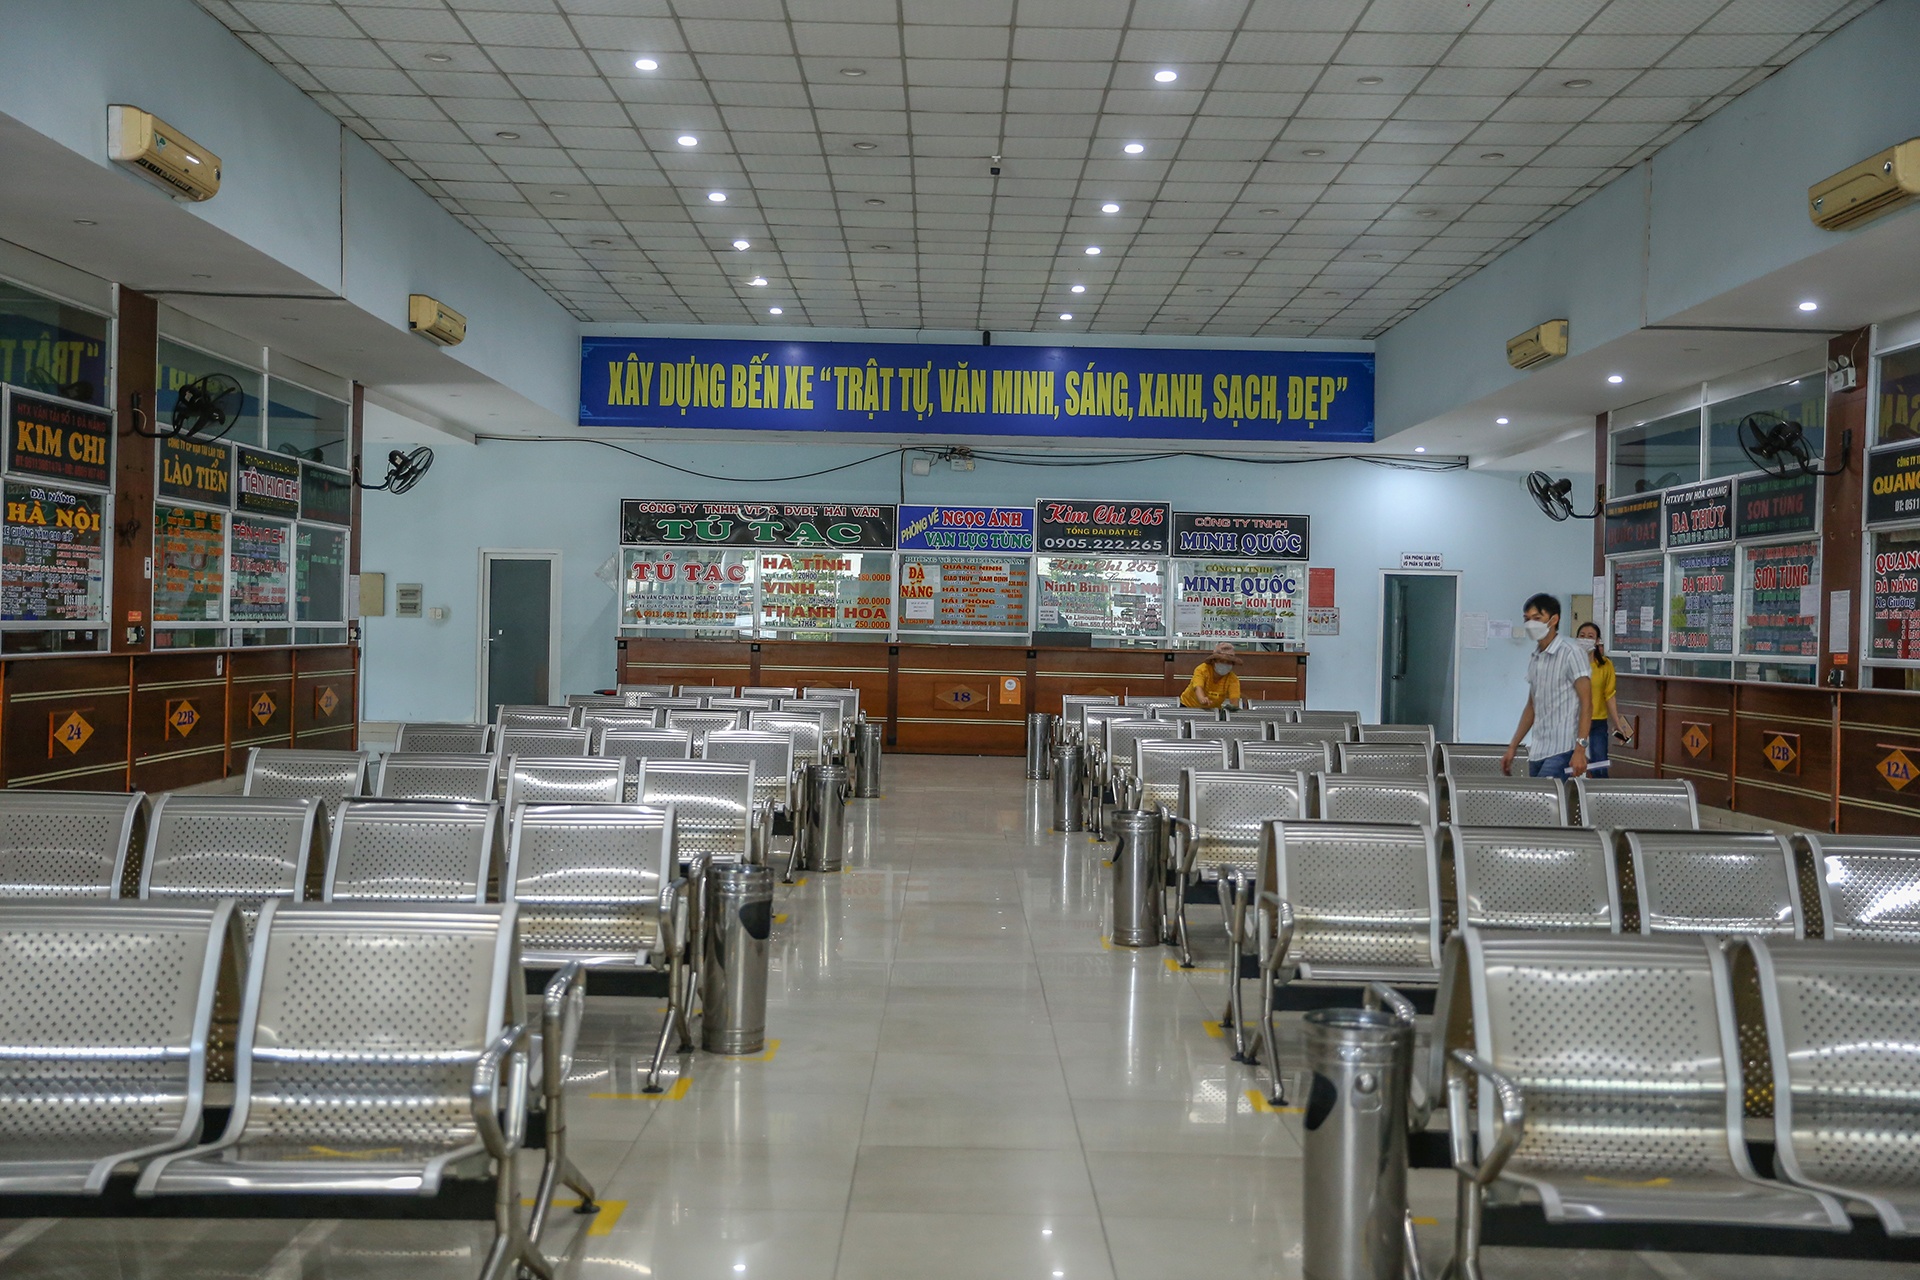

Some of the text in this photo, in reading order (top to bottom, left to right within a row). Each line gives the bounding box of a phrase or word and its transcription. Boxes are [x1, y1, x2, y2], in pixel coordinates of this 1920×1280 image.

[608, 352, 654, 406] XÂY
[659, 355, 725, 416] DỰNG
[731, 352, 779, 409] BẾN
[783, 365, 814, 410] XE
[899, 360, 934, 421] TỰ,
[939, 361, 986, 413] VĂN
[992, 369, 1059, 420] MINH,
[1065, 362, 1133, 422] SÁNG,
[1138, 373, 1207, 423] XANH,
[1213, 374, 1282, 428] SẠCH,
[17, 420, 106, 465] KIM CHI
[163, 454, 193, 487] LÀO
[243, 467, 265, 496] TÂN
[30, 488, 76, 505] ĐÀ NẴNG
[1685, 491, 1694, 502] DV
[1694, 488, 1707, 500] HÒA
[1706, 485, 1728, 498] QUANG
[639, 501, 676, 514] CÔNG
[680, 504, 698, 514] TY
[703, 504, 739, 515] TNHH
[744, 504, 762, 515] VT
[851, 506, 880, 518] VÂN
[1747, 494, 1804, 521] SƠN TÙNG
[1904, 497, 1920, 511] 0511
[8, 500, 100, 534] HÀ NỘI
[941, 507, 1022, 530] NGỌC ÁNH
[1043, 503, 1164, 526] Kim Chi 265
[1194, 516, 1288, 529] CÔNG TY TNHH
[1671, 511, 1690, 534] BA
[1690, 499, 1727, 532] THỦY
[232, 521, 253, 541] TÂN
[656, 514, 862, 547] TÚ TẠC
[901, 507, 940, 544] PHÒNG VÉ
[1066, 525, 1090, 535] TỔNG
[1092, 528, 1107, 536] ĐÀI
[1608, 517, 1634, 548] QUỐC
[1636, 522, 1658, 547] ĐẠT
[924, 530, 1033, 551] VẠN LỤC TÙNG
[1044, 537, 1162, 550] 0905.222.265
[1180, 529, 1302, 556] MINH QUỐC
[632, 551, 748, 592] TÚ TẠC
[762, 553, 852, 571] HÀ TĨNH
[908, 562, 925, 579] ĐÀ
[942, 563, 976, 571] QUẢNG
[1050, 559, 1158, 573] Kim Chi 265
[1205, 564, 1232, 573] CÔNG
[1247, 566, 1274, 574] TNHH
[1875, 550, 1920, 576] QUAN
[798, 572, 818, 580] 20H00
[1681, 567, 1725, 593] BA THỦY
[1754, 560, 1809, 590] SƠN TÙNG
[1875, 573, 1919, 594] ĐÀ NẴNG
[763, 582, 816, 595] VINH
[901, 579, 933, 598] NẴNG
[1044, 580, 1163, 597] Ninh Bình Hà Nội
[1183, 576, 1235, 594] MINH
[1240, 574, 1296, 596] QUỐC
[1203, 594, 1292, 608] NẴNG KON TUM
[1875, 595, 1916, 610] Xe Giường
[762, 605, 836, 619] THANH
[953, 691, 971, 702] 18
[176, 709, 195, 726] 22B
[257, 702, 272, 716] 22A
[67, 722, 82, 741] 24
[1771, 745, 1789, 762] 12B
[1886, 761, 1911, 780] 12A
